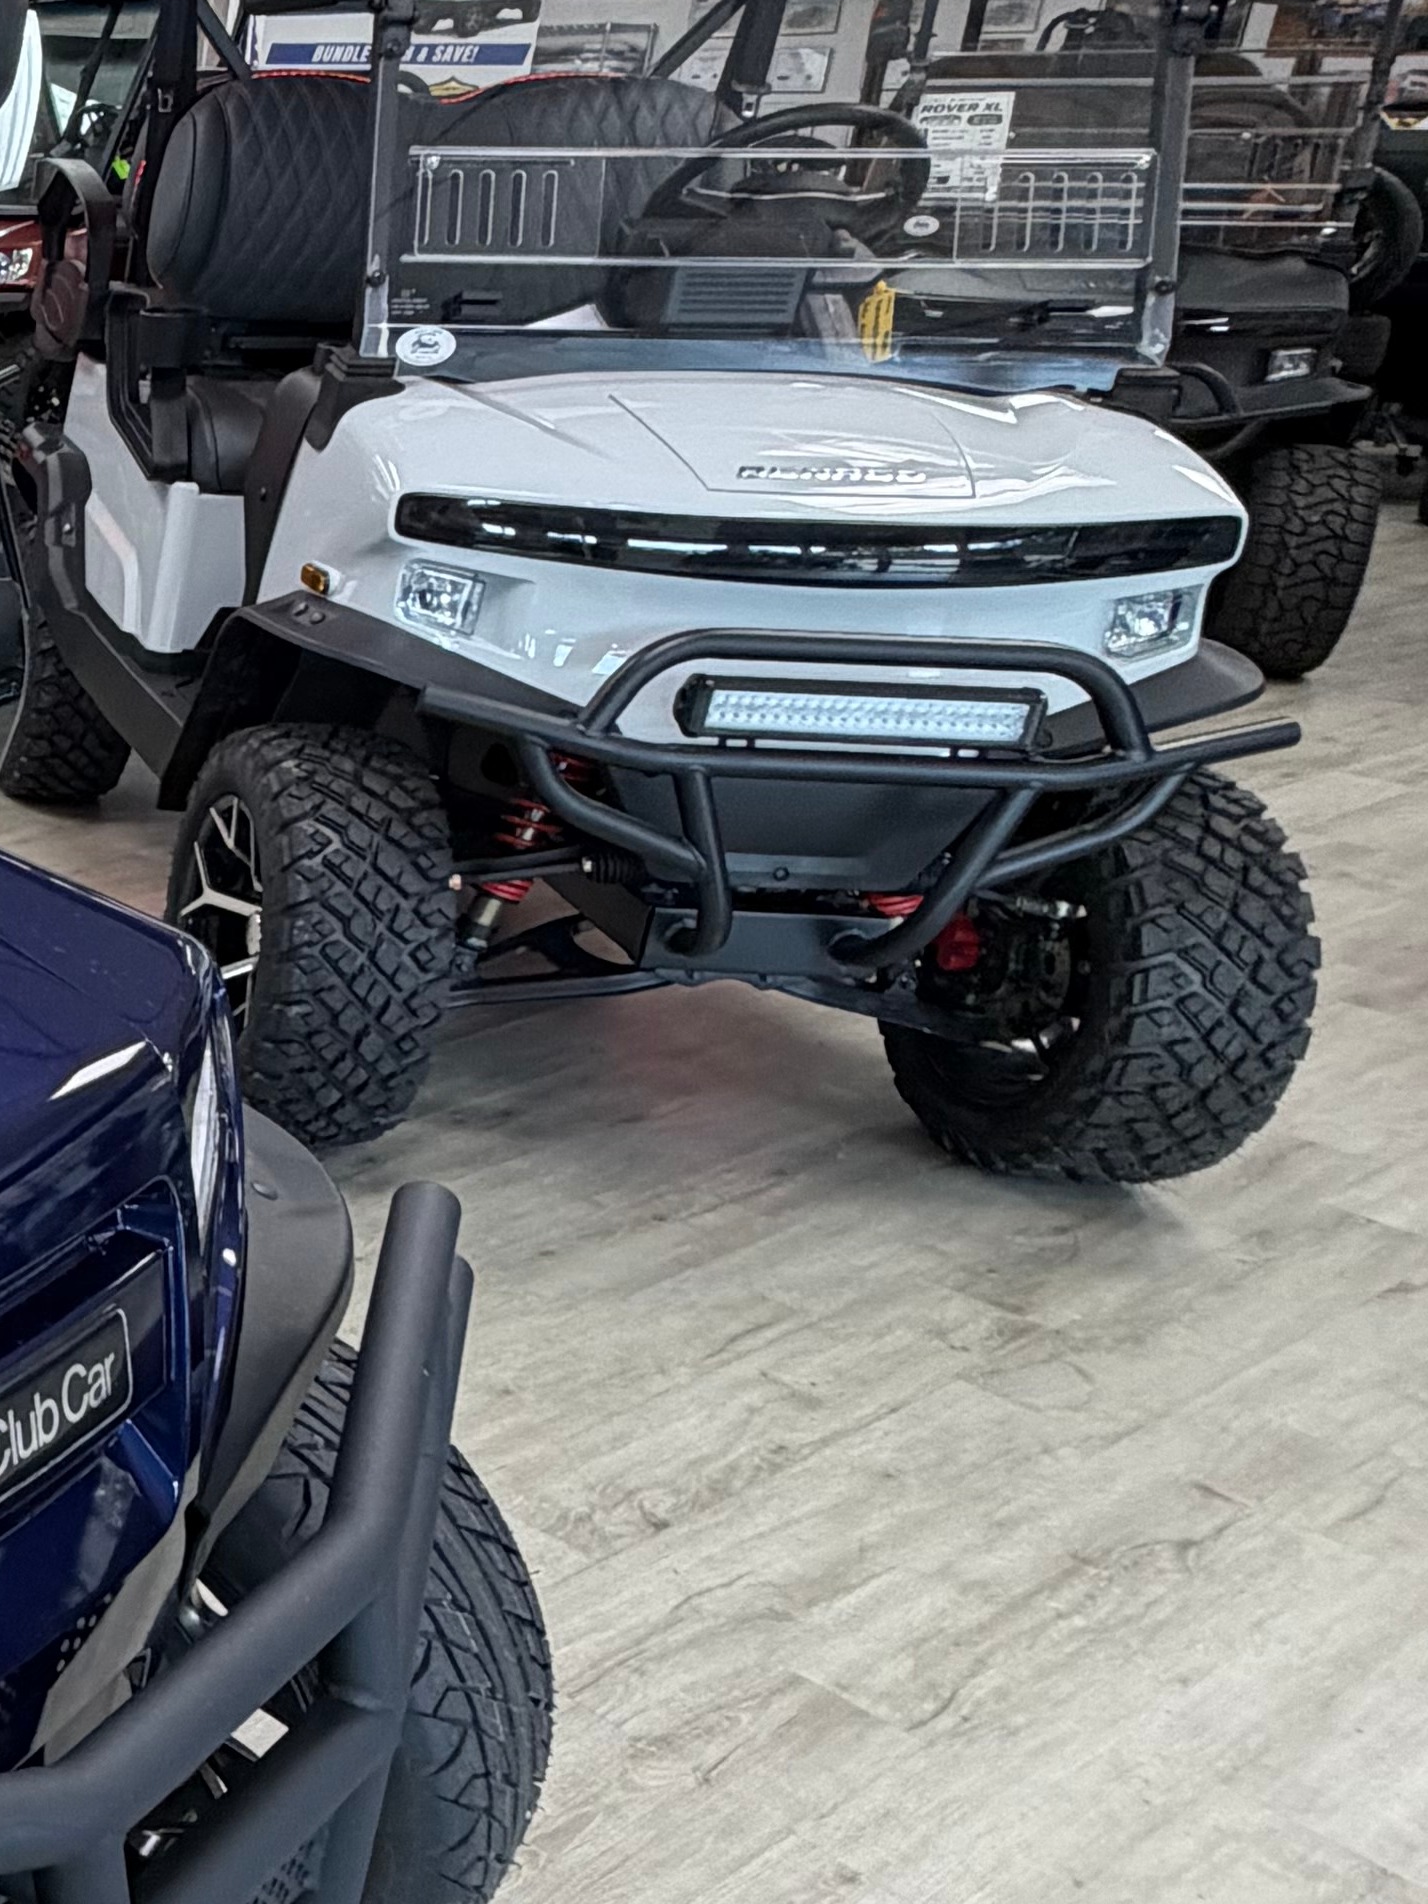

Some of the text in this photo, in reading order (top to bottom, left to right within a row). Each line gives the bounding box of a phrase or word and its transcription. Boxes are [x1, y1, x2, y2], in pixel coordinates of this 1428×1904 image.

[311, 44, 372, 64] BUNDLE
[431, 44, 480, 64] SAVE!
[920, 101, 1004, 114] ROVER XL
[60, 1351, 117, 1425] Car
